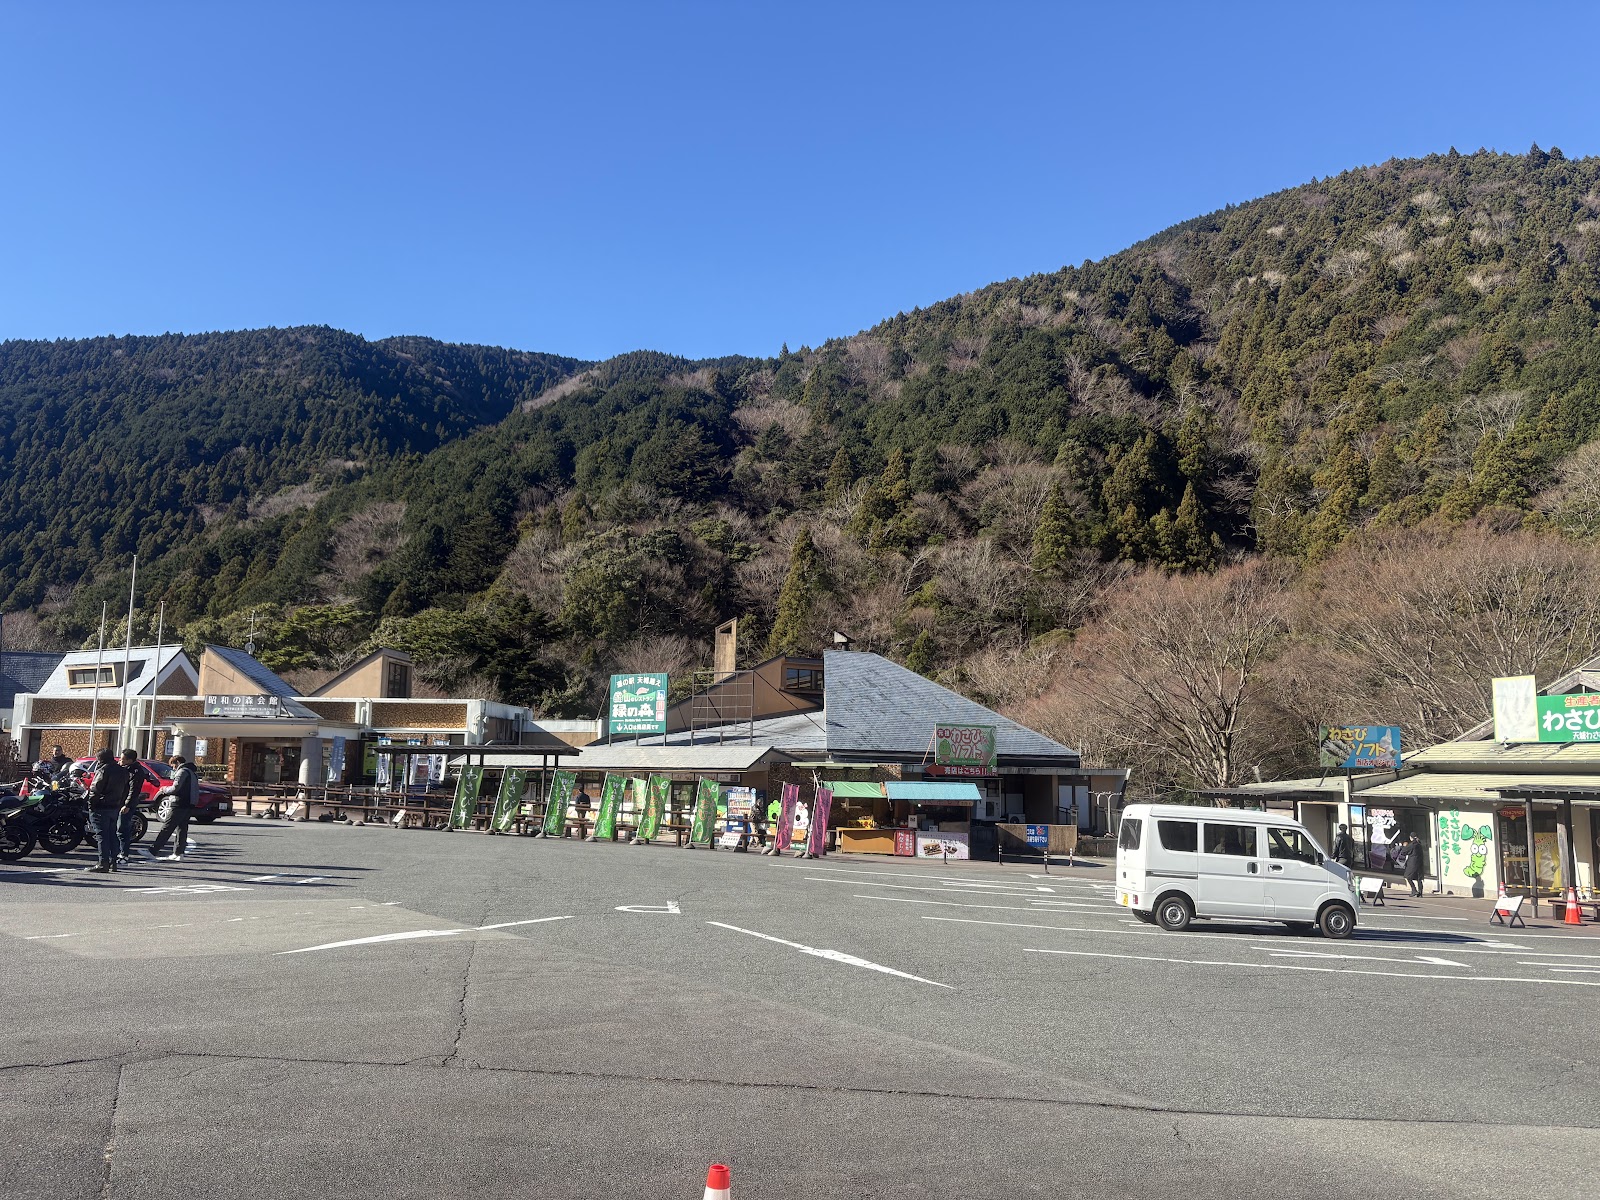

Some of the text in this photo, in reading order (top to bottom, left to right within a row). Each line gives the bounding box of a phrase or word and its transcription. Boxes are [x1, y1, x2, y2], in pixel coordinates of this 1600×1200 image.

[208, 696, 278, 705] 昭和の森会館
[612, 703, 655, 718] 緑の森
[1328, 727, 1368, 741] わさび
[951, 744, 983, 760] ソフト
[1351, 743, 1386, 757] ソフト
[1449, 804, 1461, 855] わさびを
